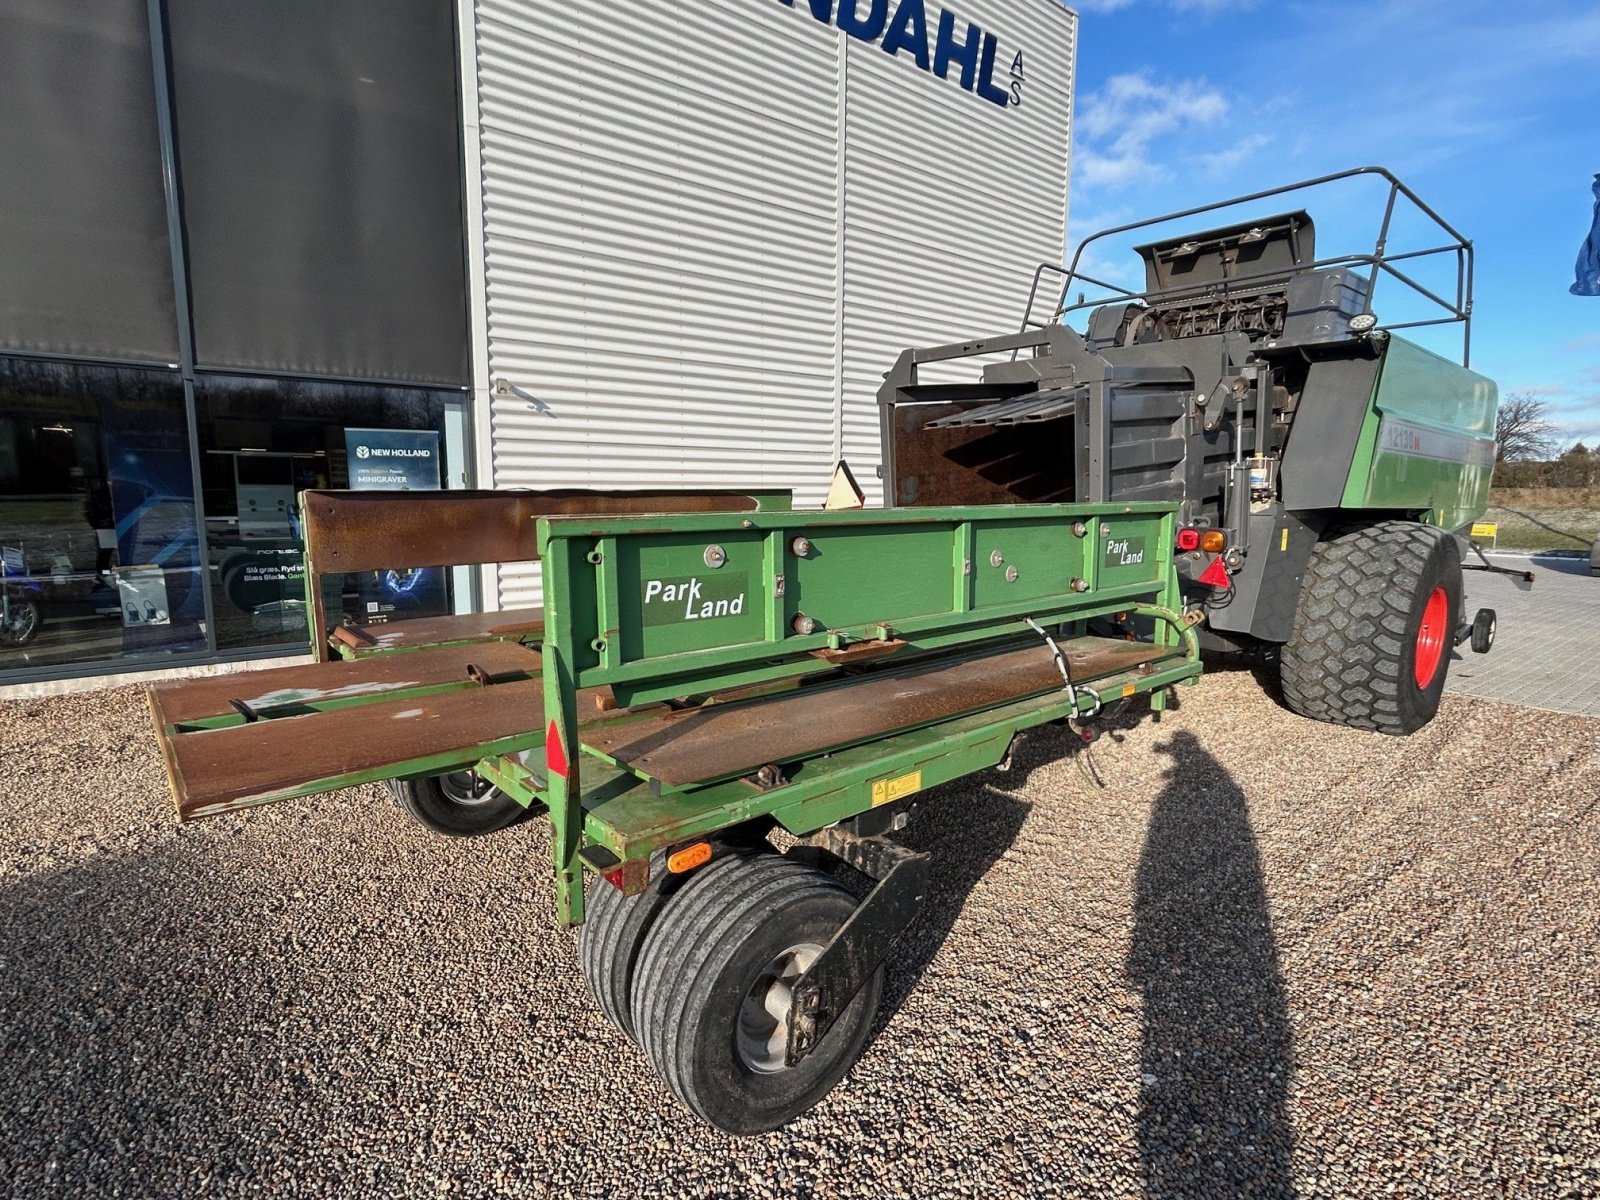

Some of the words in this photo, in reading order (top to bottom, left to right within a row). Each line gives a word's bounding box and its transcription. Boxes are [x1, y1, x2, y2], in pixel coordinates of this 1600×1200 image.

[371, 448, 390, 456] NEW
[391, 449, 430, 457] HOLLAND
[1107, 539, 1129, 554] Park
[1120, 549, 1144, 565] Land
[281, 565, 296, 573] Ryd
[645, 578, 703, 604] Park
[685, 593, 745, 620] Land
